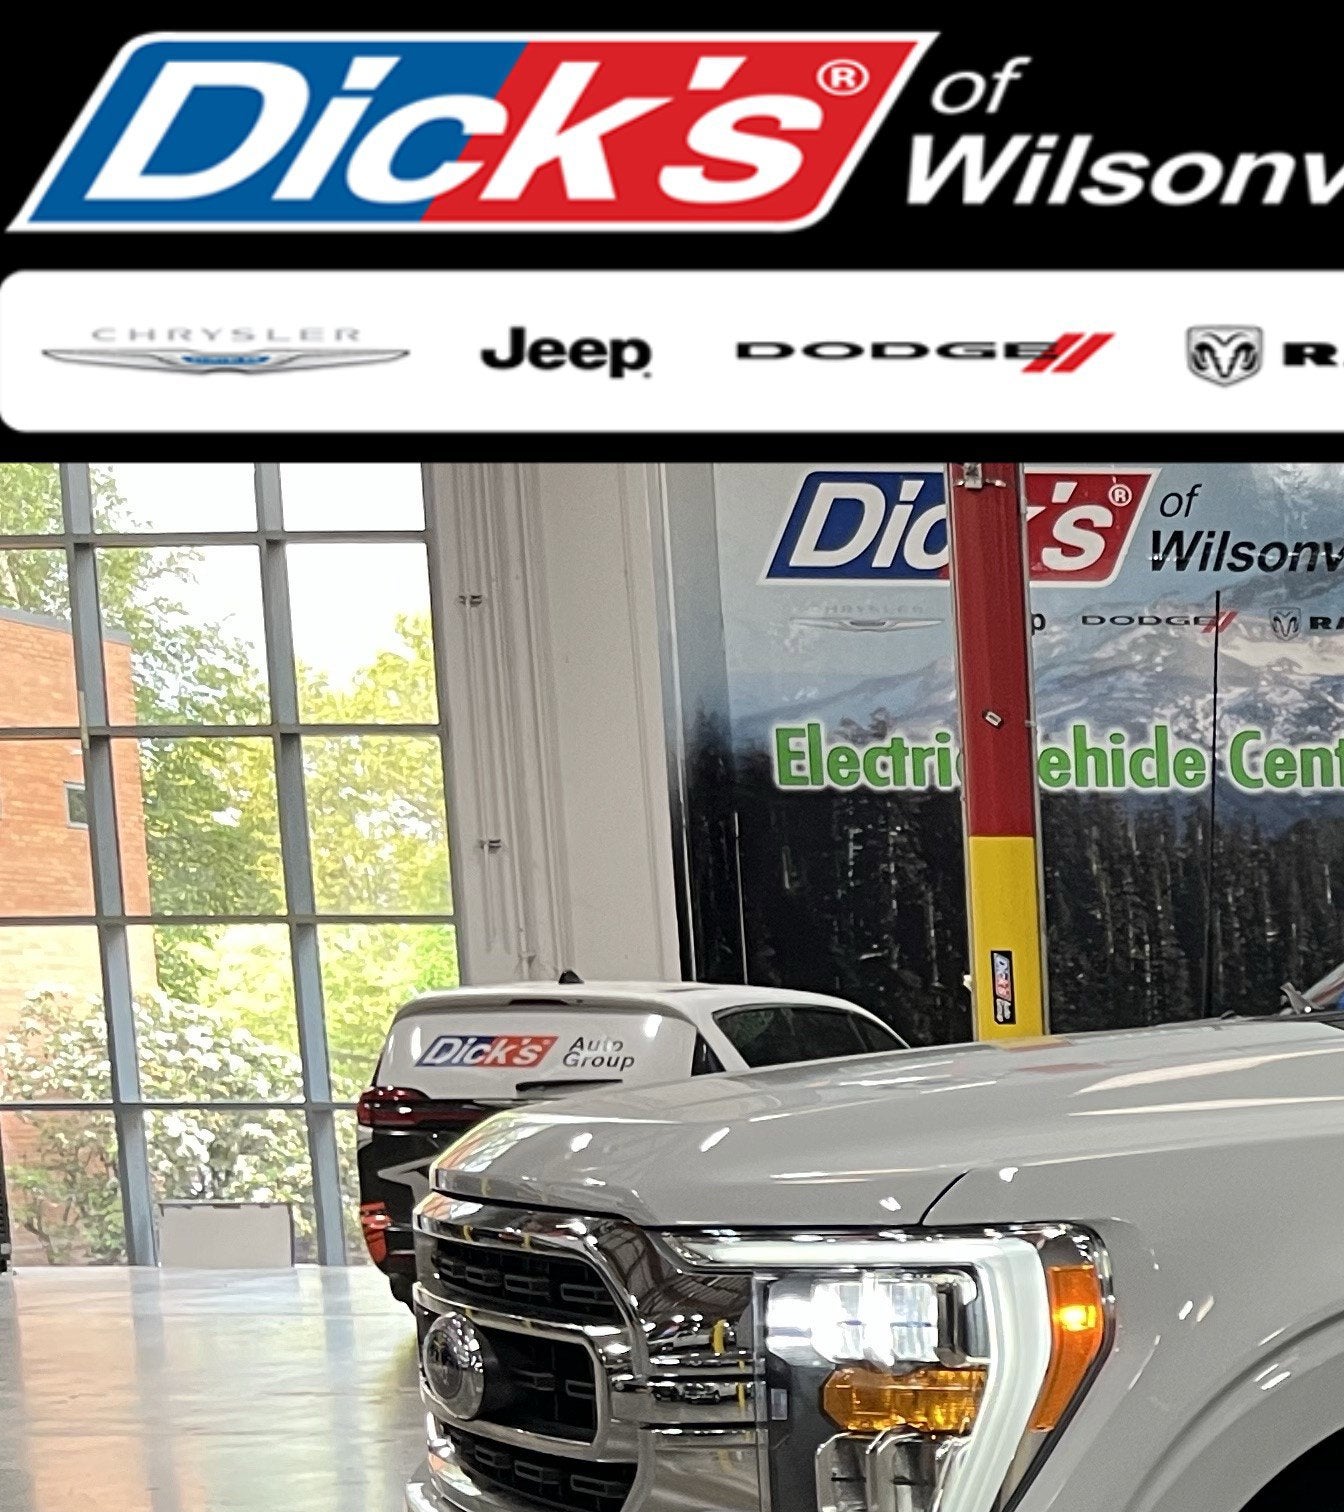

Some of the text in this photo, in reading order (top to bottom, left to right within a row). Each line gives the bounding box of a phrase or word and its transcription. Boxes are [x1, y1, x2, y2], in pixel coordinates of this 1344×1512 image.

[1159, 483, 1203, 518] of
[1081, 615, 1214, 626] DODGE
[775, 723, 964, 788] Electri
[1037, 724, 1206, 788] ehicle
[422, 1037, 543, 1067] Dick's
[568, 1036, 625, 1052] Auto
[562, 1051, 635, 1072] Group
